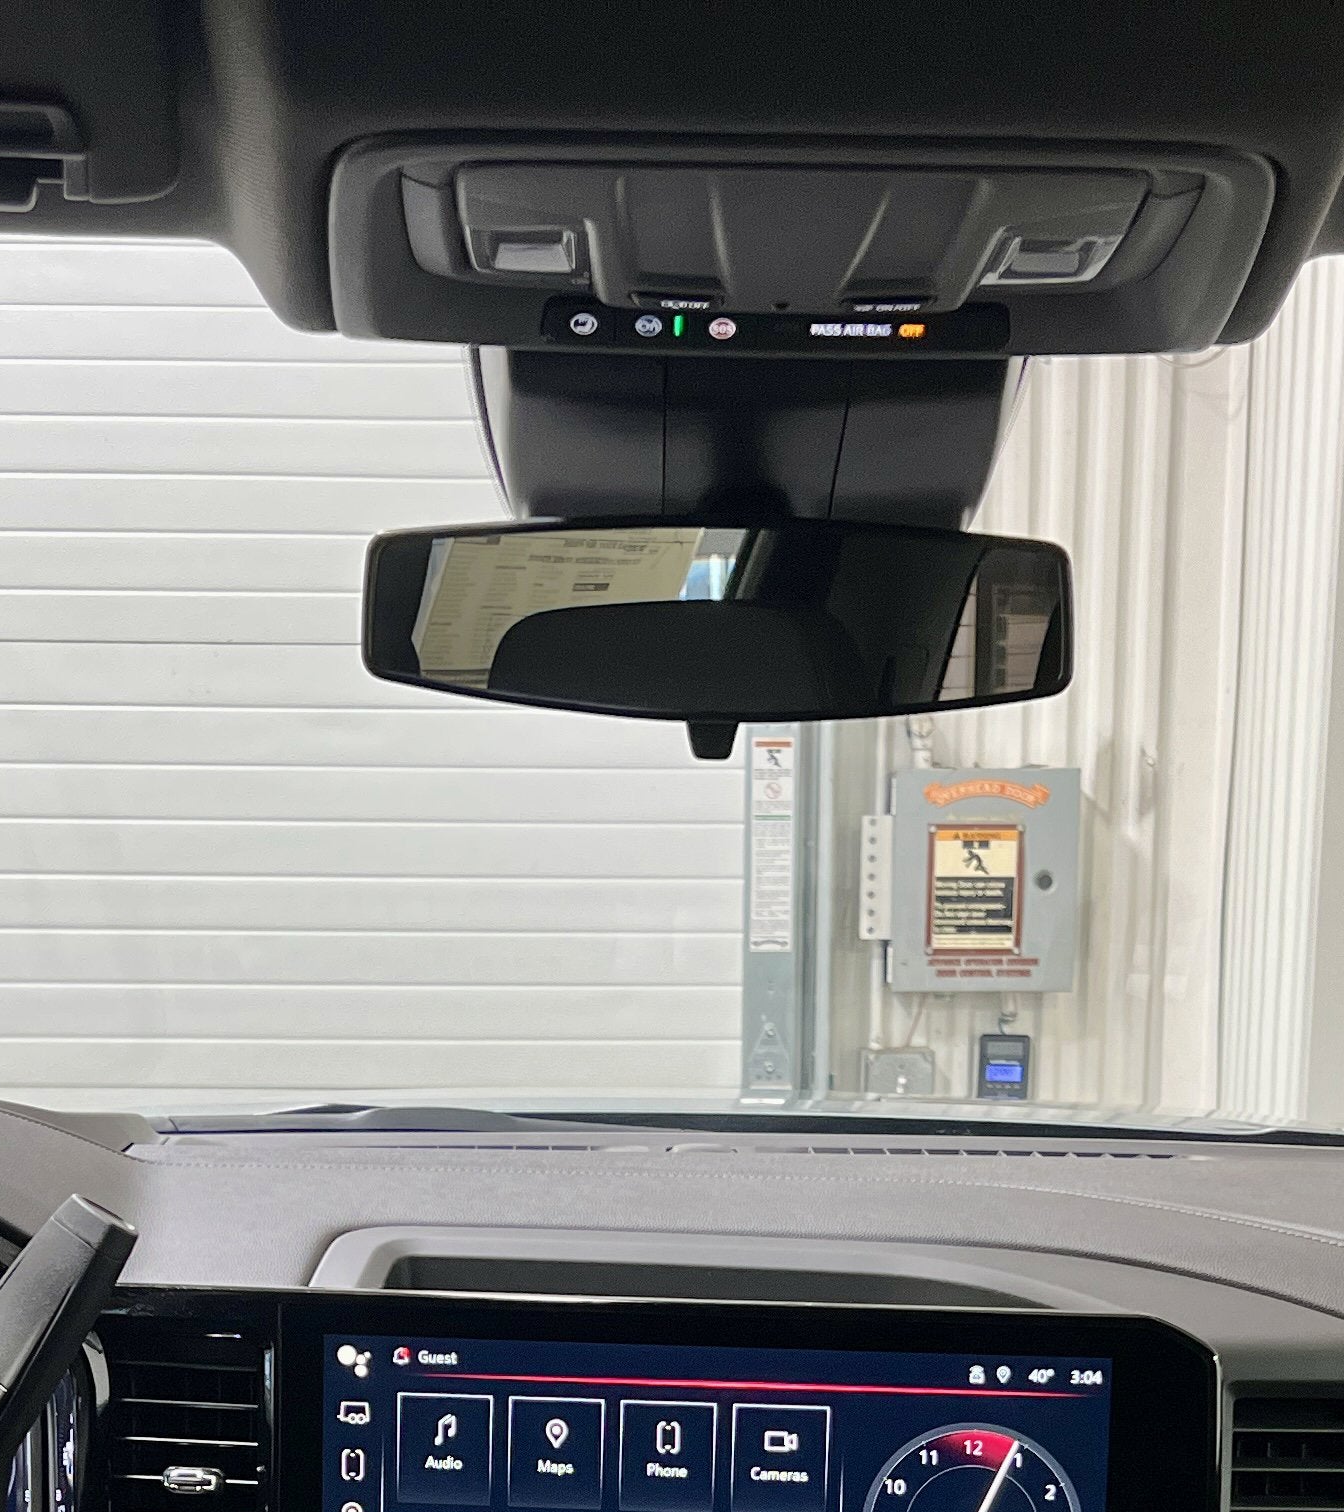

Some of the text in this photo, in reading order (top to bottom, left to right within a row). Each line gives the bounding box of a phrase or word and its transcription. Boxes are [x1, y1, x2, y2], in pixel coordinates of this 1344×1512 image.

[810, 323, 842, 336] PASS
[843, 323, 865, 336] AIR
[898, 323, 926, 338] OFF
[417, 1350, 458, 1365] Guest
[1070, 1369, 1103, 1385] 3:04
[963, 1440, 983, 1456] 12
[425, 1456, 463, 1470] Audio
[919, 1449, 939, 1465] 11
[1014, 1452, 1023, 1468] 1
[537, 1459, 574, 1476] Maps
[646, 1462, 688, 1478] Phone
[750, 1466, 809, 1482] Cameras
[885, 1479, 907, 1495] 10
[1044, 1484, 1056, 1500] 2
